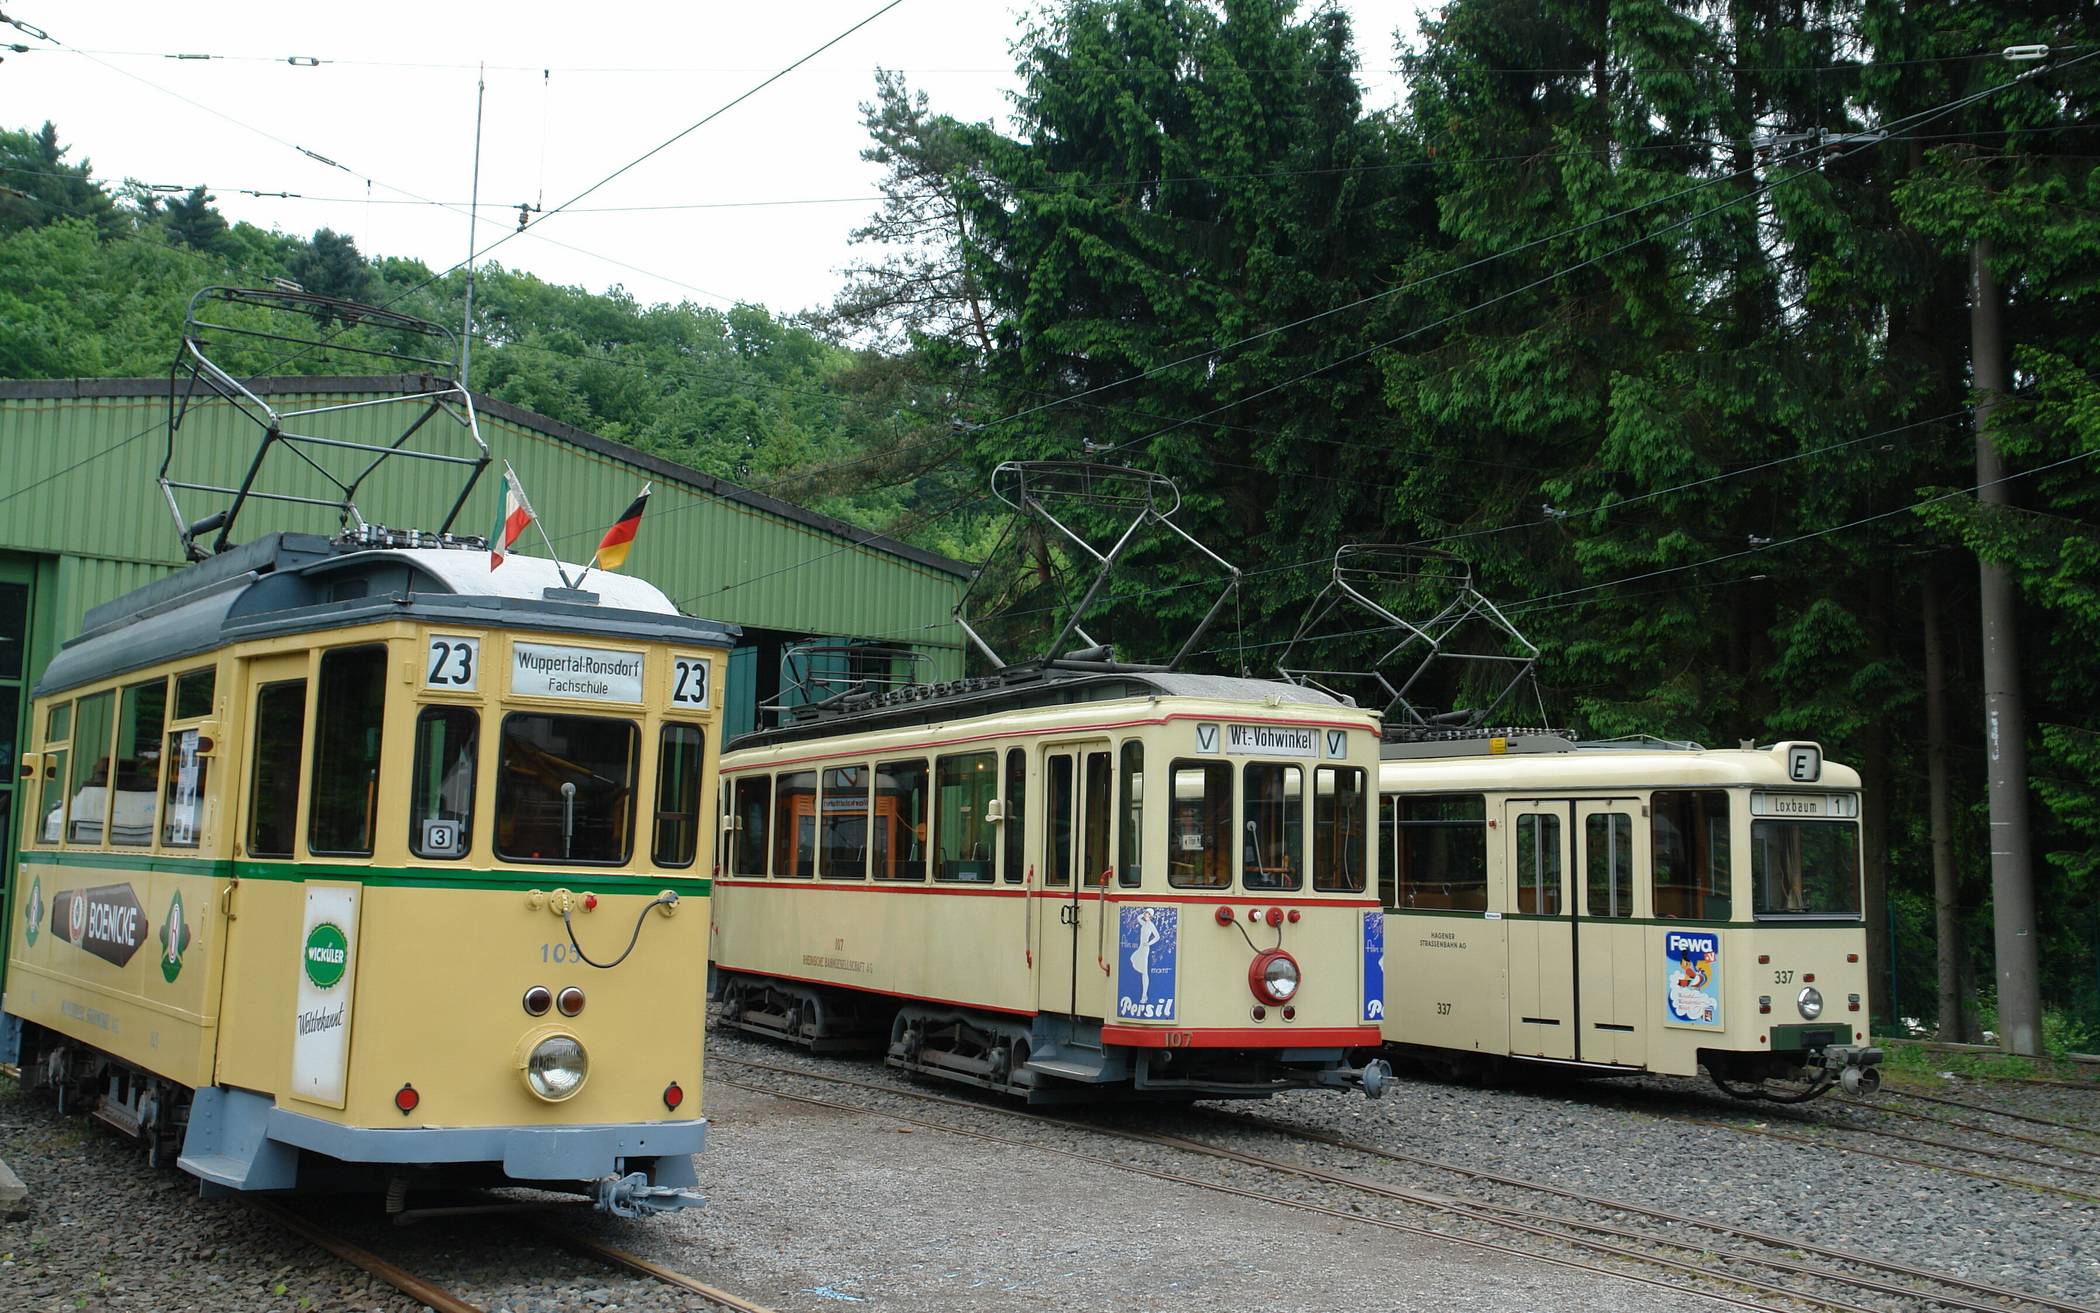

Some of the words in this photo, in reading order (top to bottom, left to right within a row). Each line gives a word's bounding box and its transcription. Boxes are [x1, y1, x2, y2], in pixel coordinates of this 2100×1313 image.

[428, 641, 473, 685] 23
[518, 652, 640, 677] Wuppertal-Ronsdorf
[548, 677, 608, 695] Fachschule
[673, 661, 706, 703] 23
[1197, 727, 1215, 750] V
[1327, 732, 1341, 754] V
[1794, 755, 1807, 778] E
[1775, 798, 1817, 813] Loxbaum
[1835, 798, 1841, 814] 1
[435, 829, 446, 846] 3
[88, 901, 137, 946] BOENICKE
[1419, 939, 1458, 949] STRASSENBAHN
[1430, 931, 1456, 940] HAGENER
[1670, 935, 1713, 953] Fewa
[308, 942, 344, 964] WICKÜLER
[541, 943, 581, 963] 105
[1774, 970, 1794, 984] 337
[1120, 996, 1173, 1018] Persil
[1437, 1002, 1451, 1016] 337
[298, 1001, 344, 1036] Weltbekannt
[1165, 1031, 1193, 1047] 107
